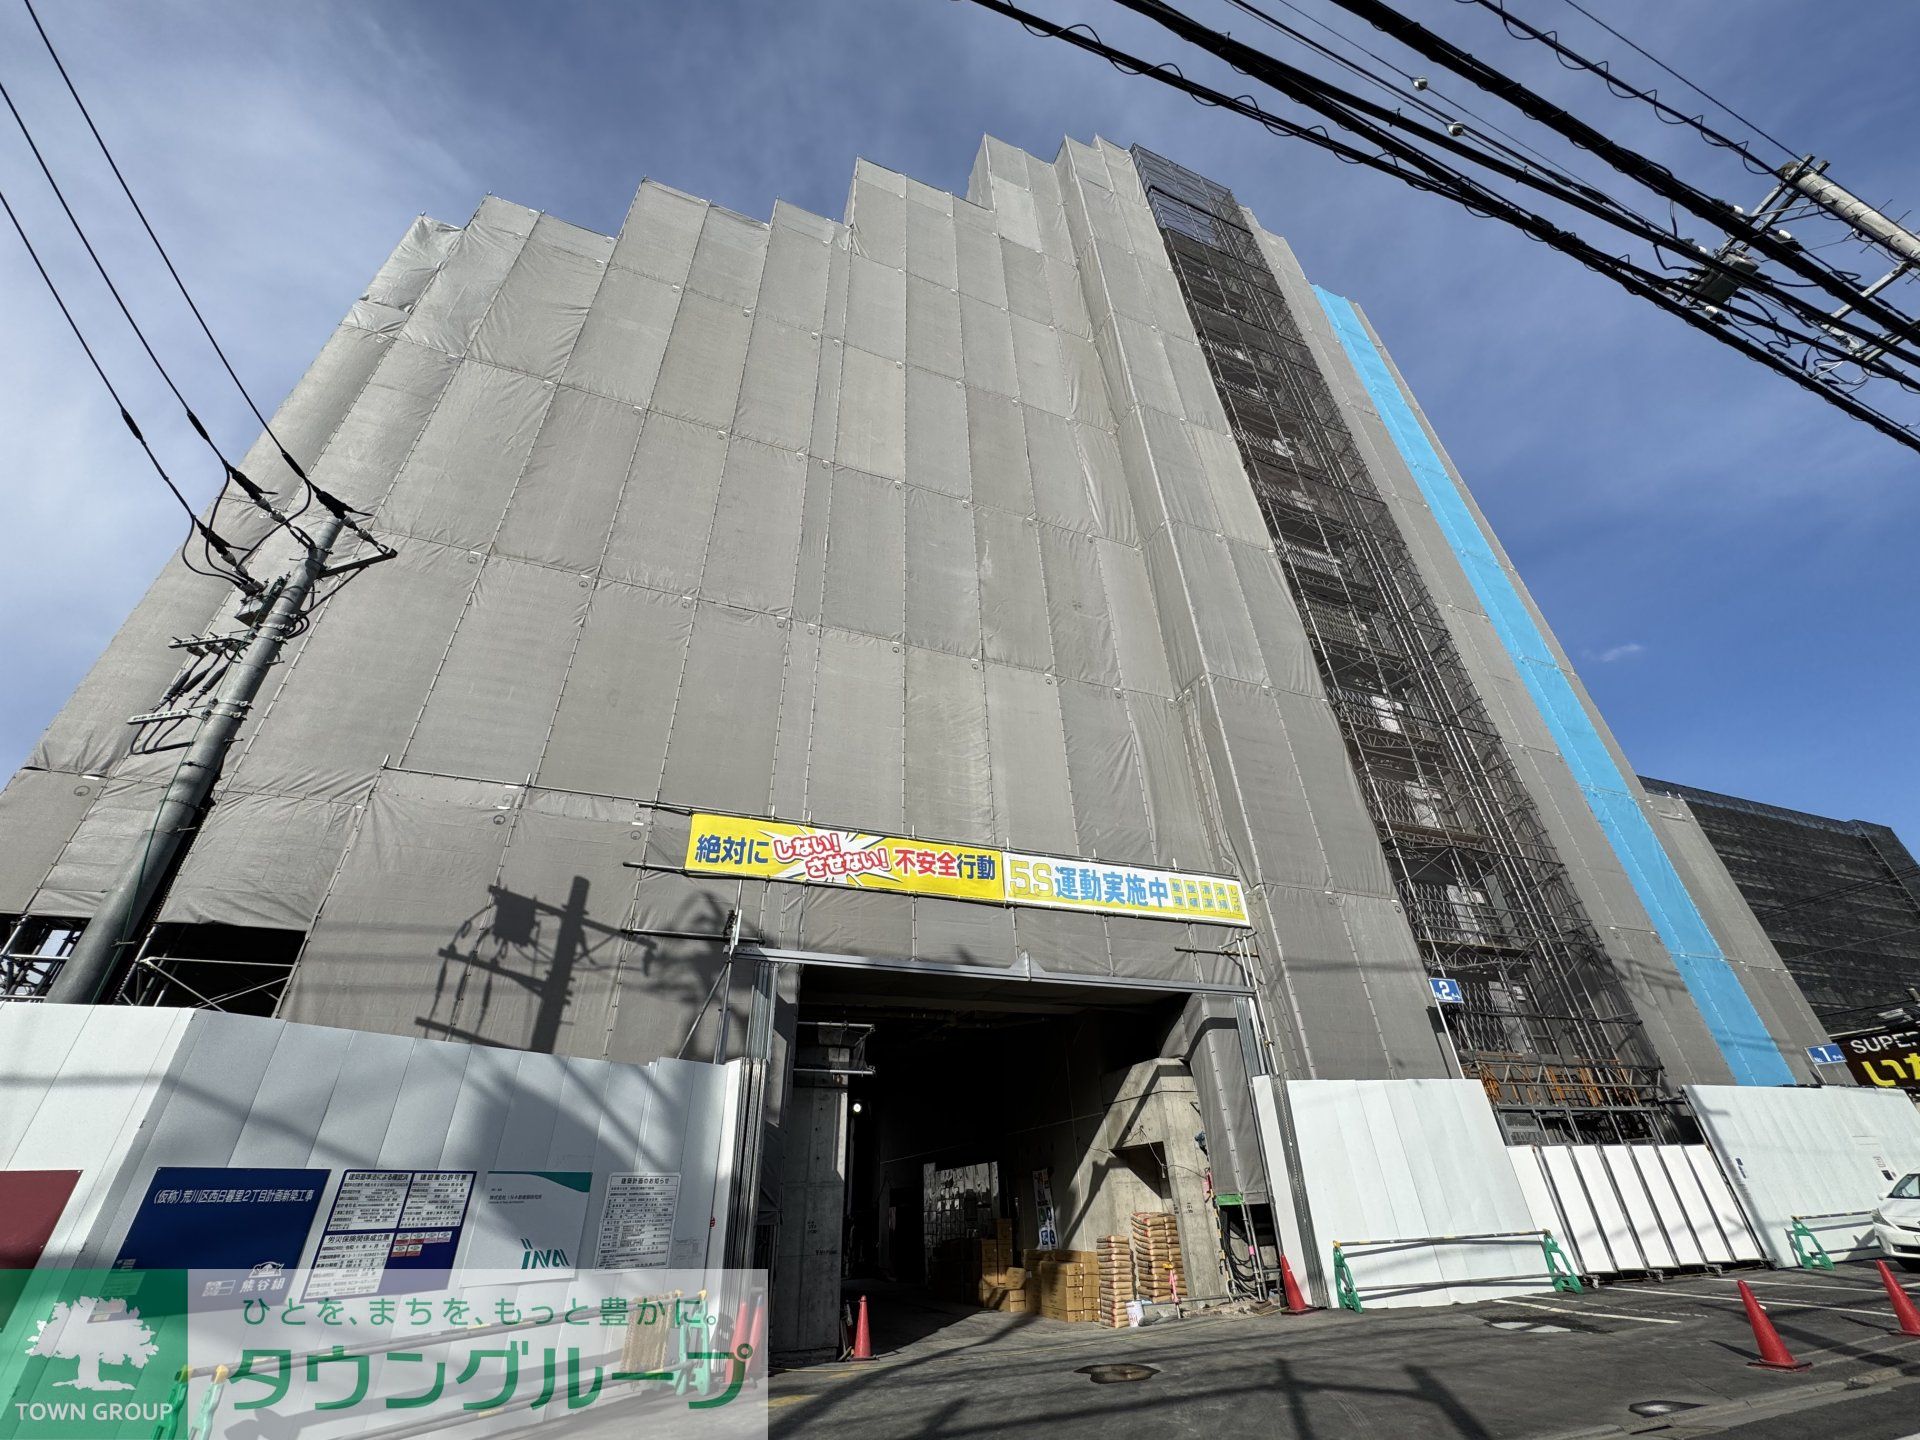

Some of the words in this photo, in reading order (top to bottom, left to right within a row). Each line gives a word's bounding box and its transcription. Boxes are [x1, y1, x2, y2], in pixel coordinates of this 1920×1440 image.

[695, 834, 769, 864] 絶対に
[895, 849, 995, 880] 不安全行動
[621, 1177, 670, 1185] 建築計画のお知らせ
[327, 1233, 391, 1244] 労災保険関係成立票
[239, 1277, 286, 1293] 熊谷組
